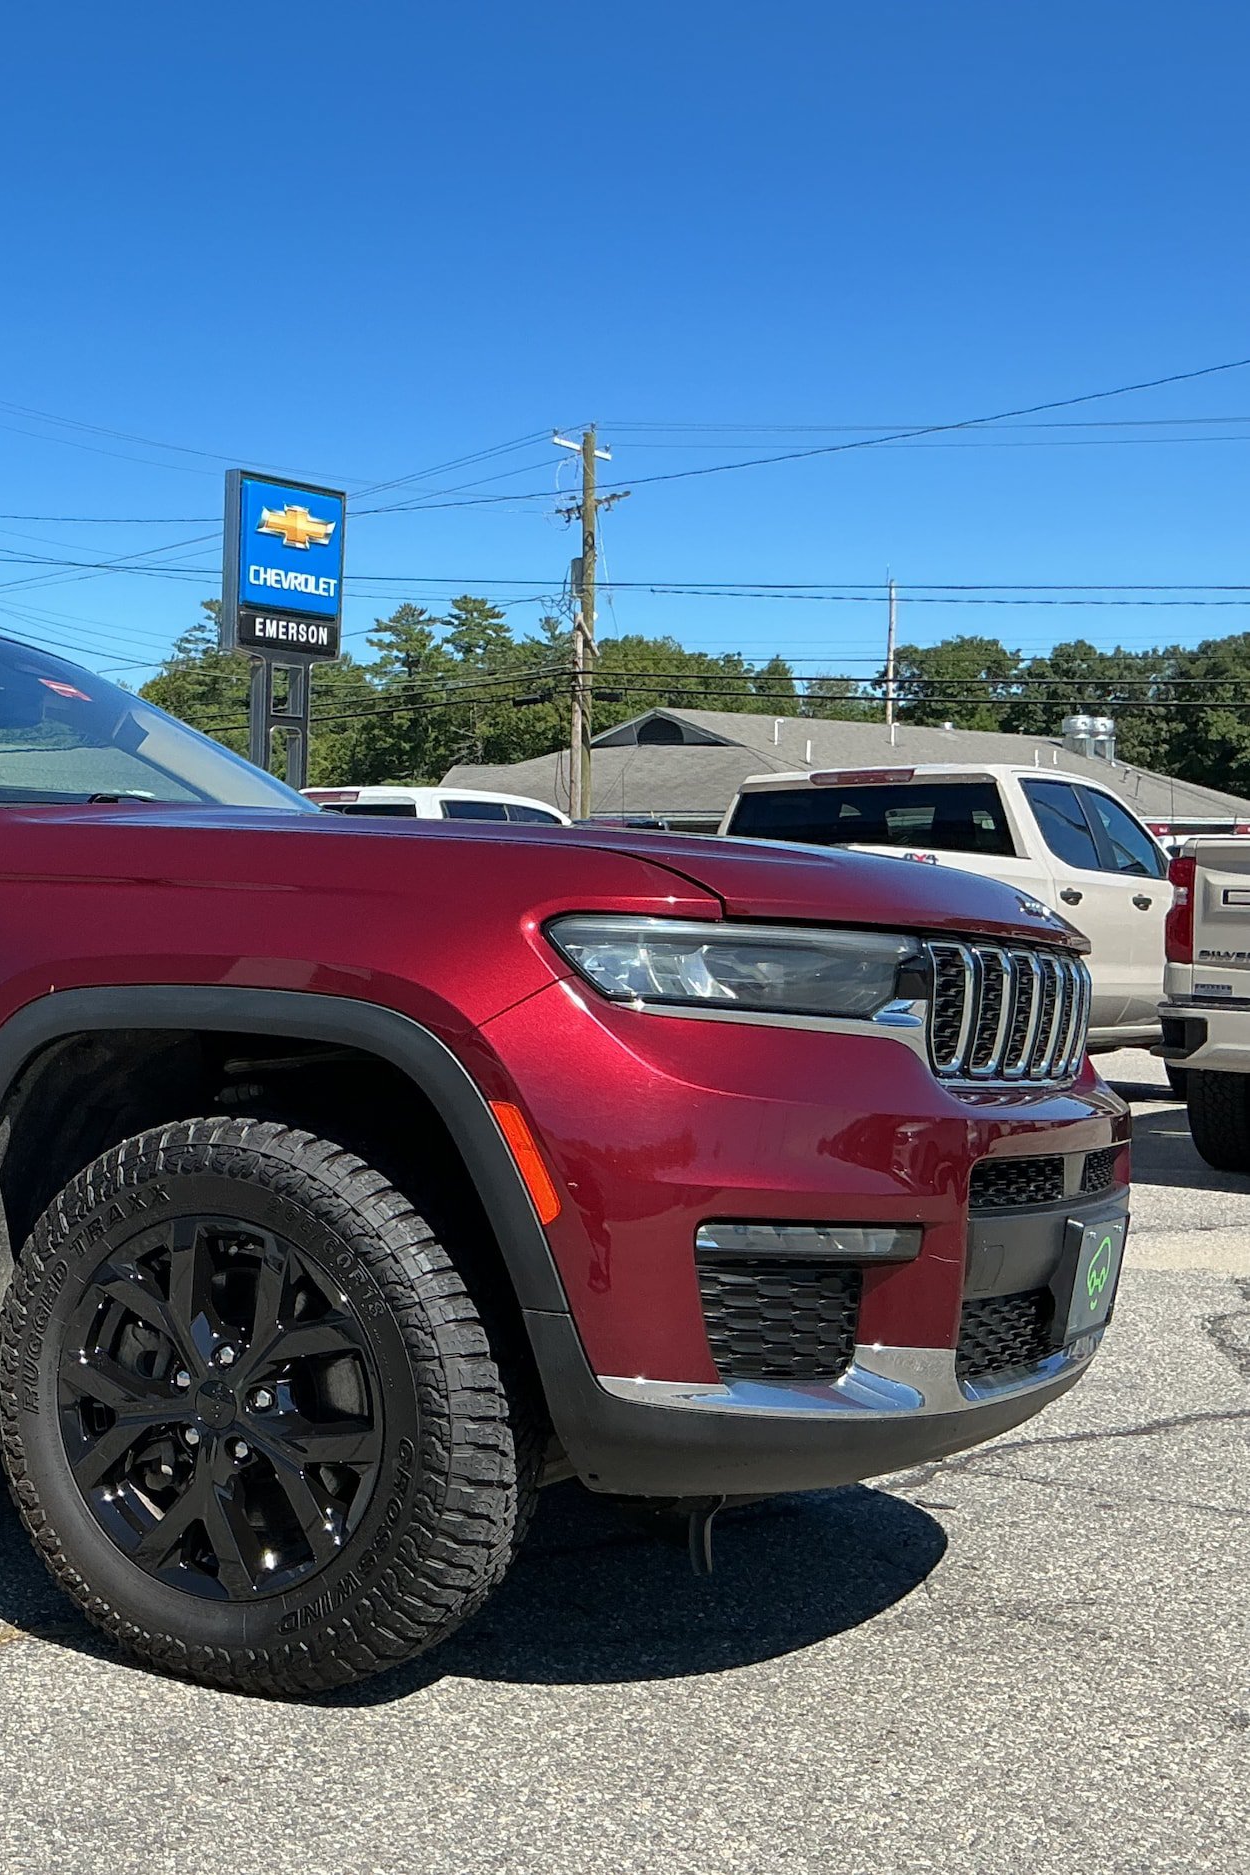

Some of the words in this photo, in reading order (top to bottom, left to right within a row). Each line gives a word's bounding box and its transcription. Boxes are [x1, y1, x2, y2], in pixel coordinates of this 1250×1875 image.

[249, 564, 338, 598] CHEVROLET
[254, 617, 328, 646] EMERSON
[1198, 950, 1250, 960] SILVE
[22, 1258, 69, 1415] RUGGED
[68, 1183, 171, 1258] TRAXX
[277, 1436, 416, 1636] CROSSWIND
